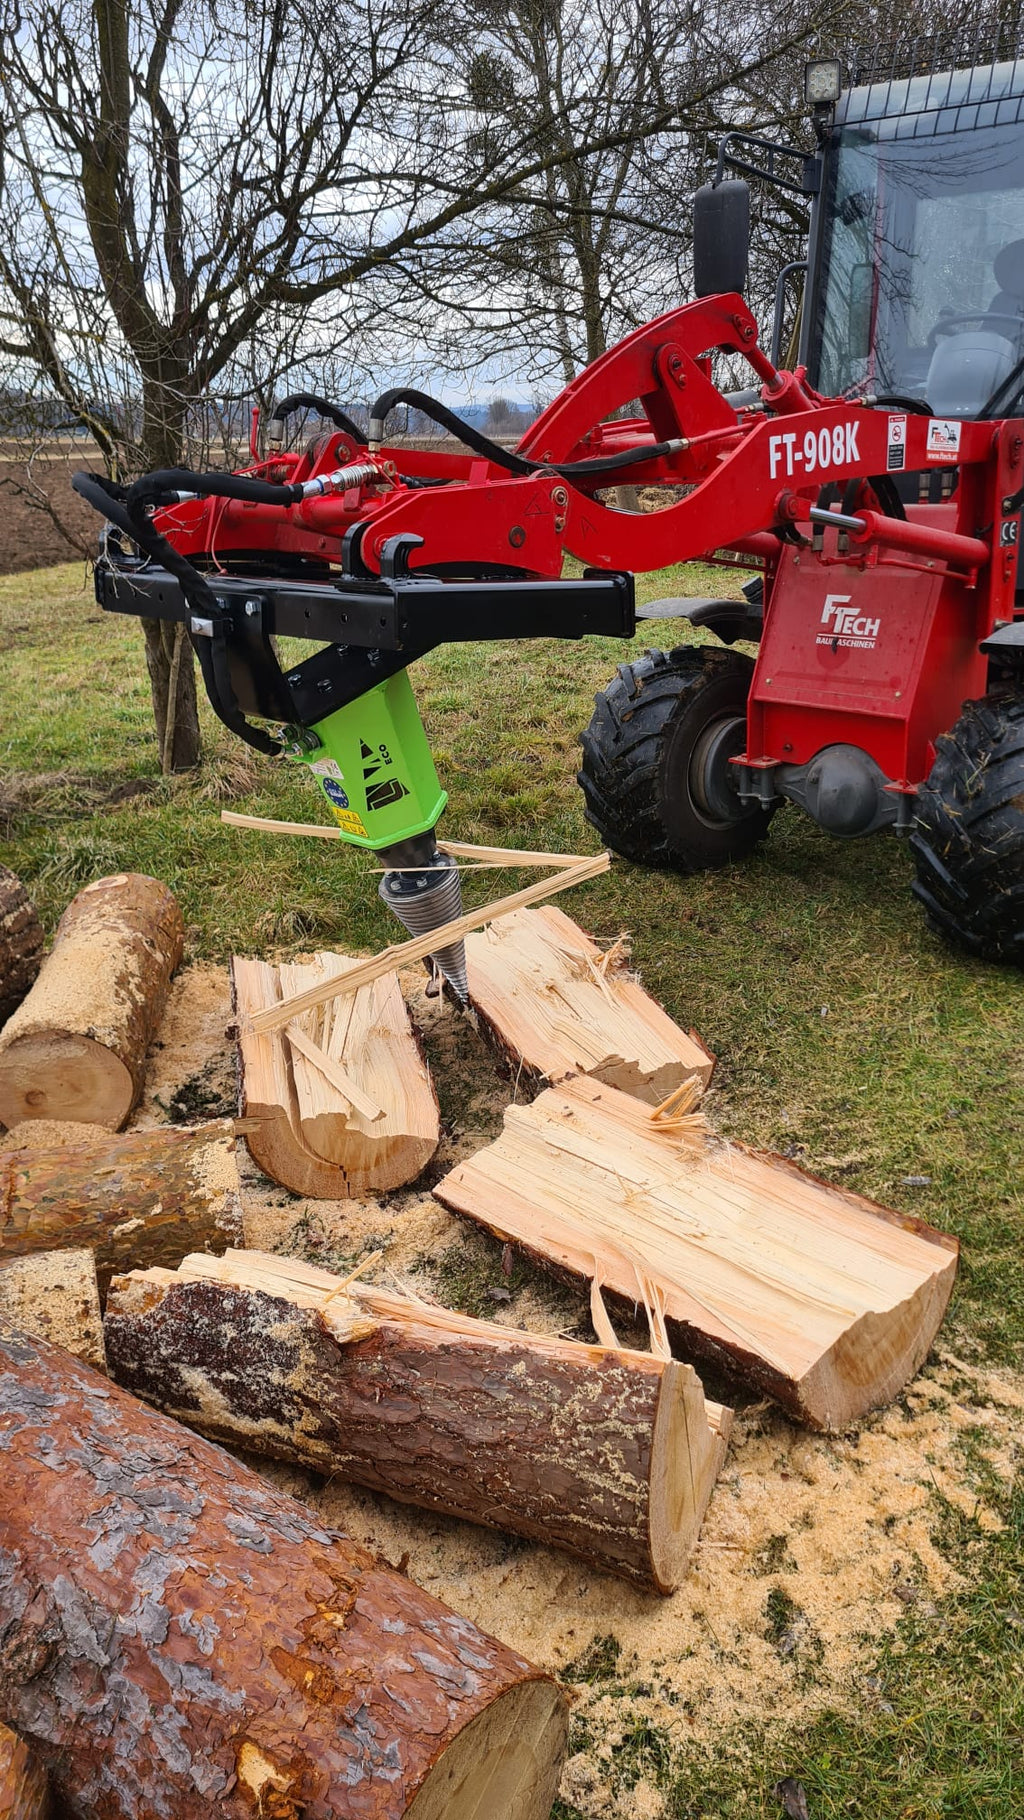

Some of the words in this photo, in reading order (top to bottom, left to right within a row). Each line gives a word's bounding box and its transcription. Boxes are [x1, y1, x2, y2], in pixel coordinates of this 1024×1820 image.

[769, 421, 860, 479] FT-908K
[1002, 521, 1017, 540] CE
[816, 637, 876, 649] BAUASCHINEN
[379, 744, 393, 765] ECO
